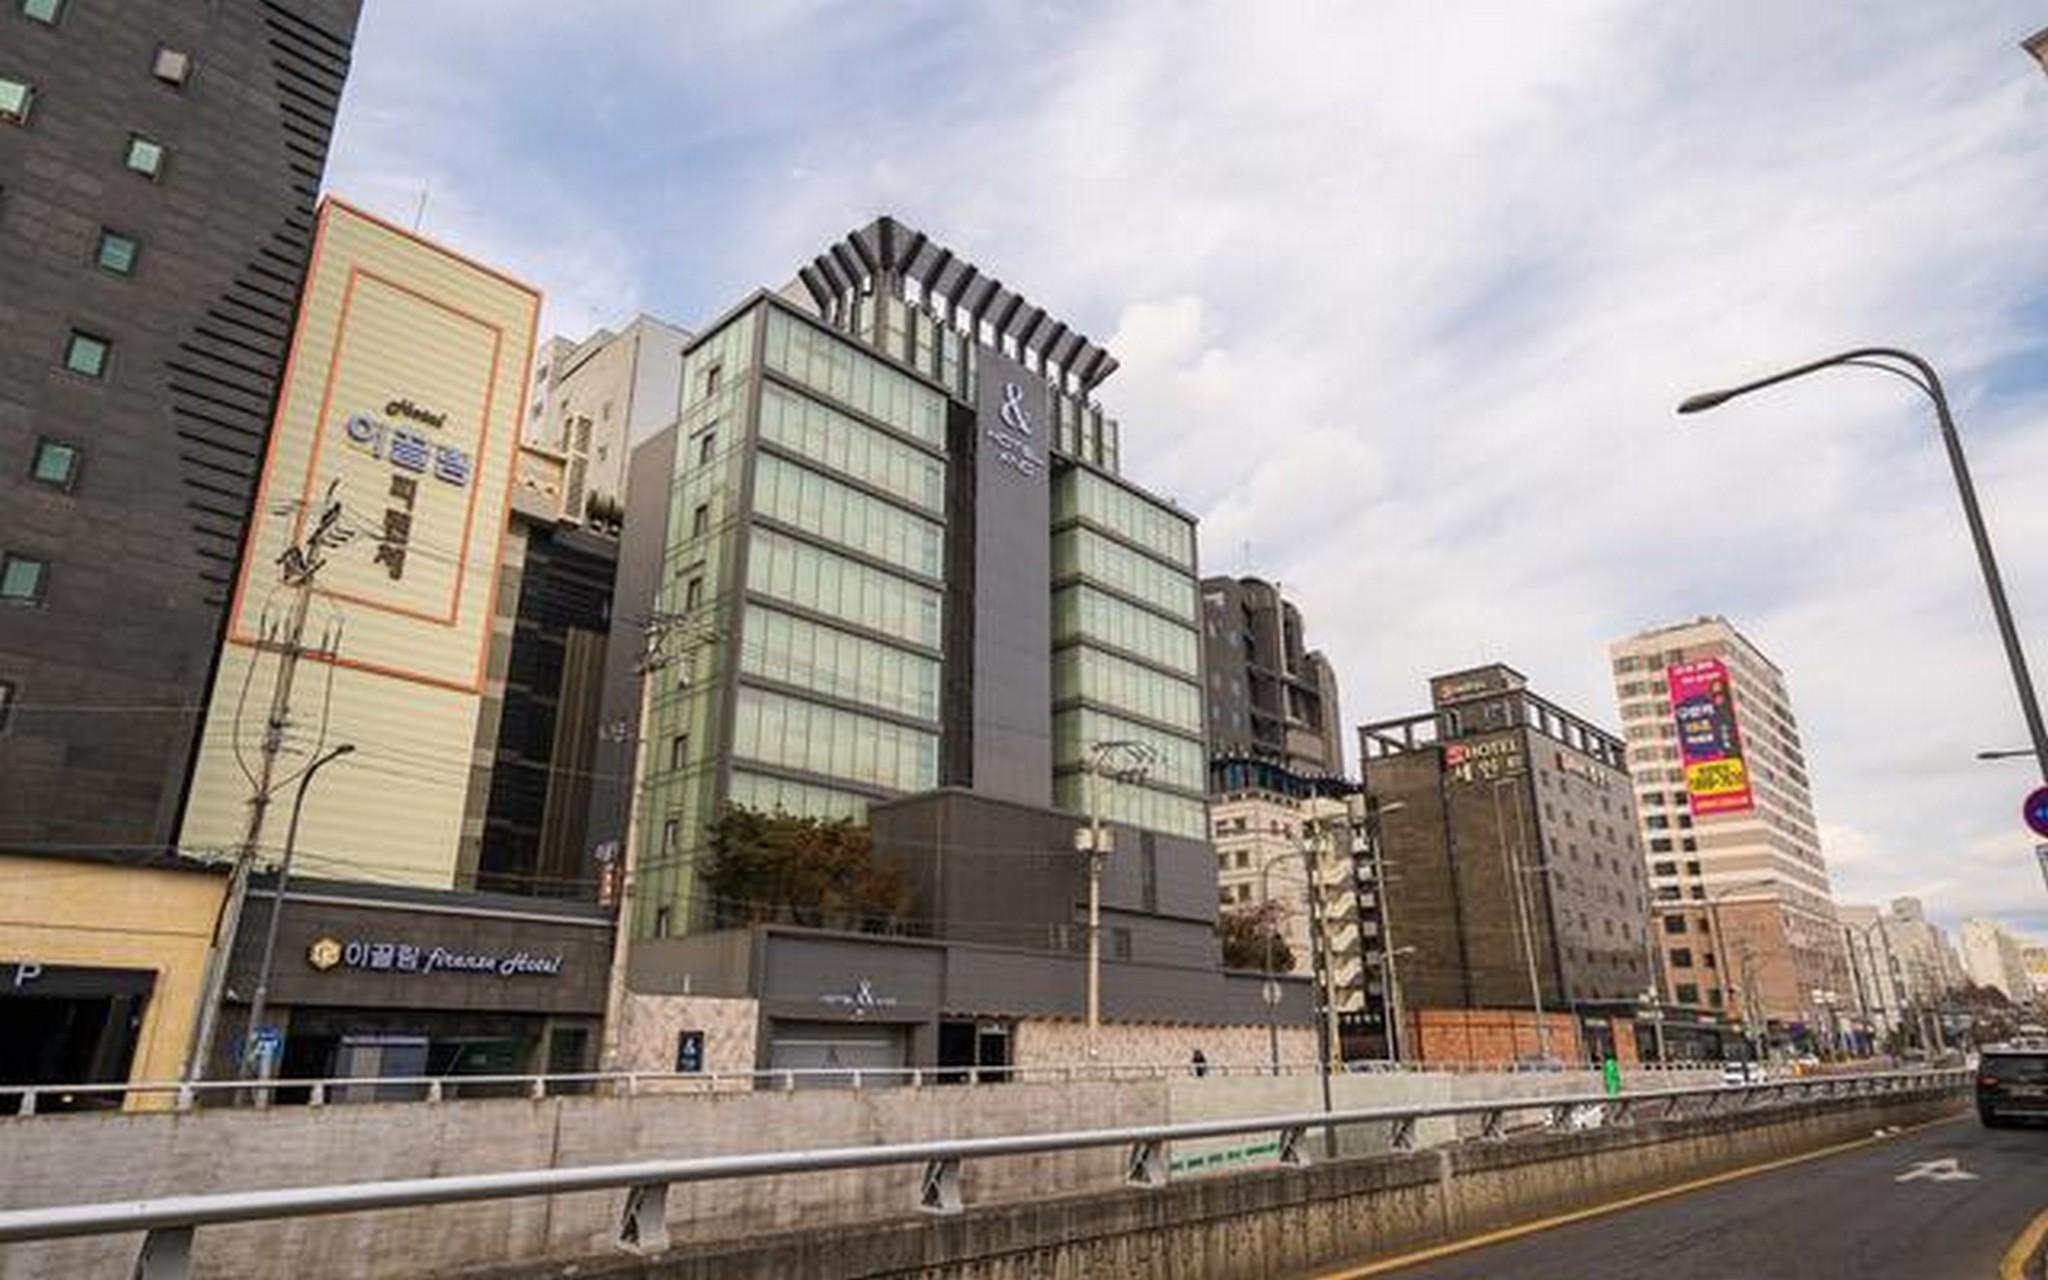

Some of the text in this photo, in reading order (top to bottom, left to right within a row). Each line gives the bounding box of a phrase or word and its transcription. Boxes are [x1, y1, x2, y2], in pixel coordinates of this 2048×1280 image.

[385, 398, 448, 429] Hotel
[344, 940, 420, 970] 이끌림
[498, 951, 563, 976] Hotel
[14, 963, 42, 988] P
